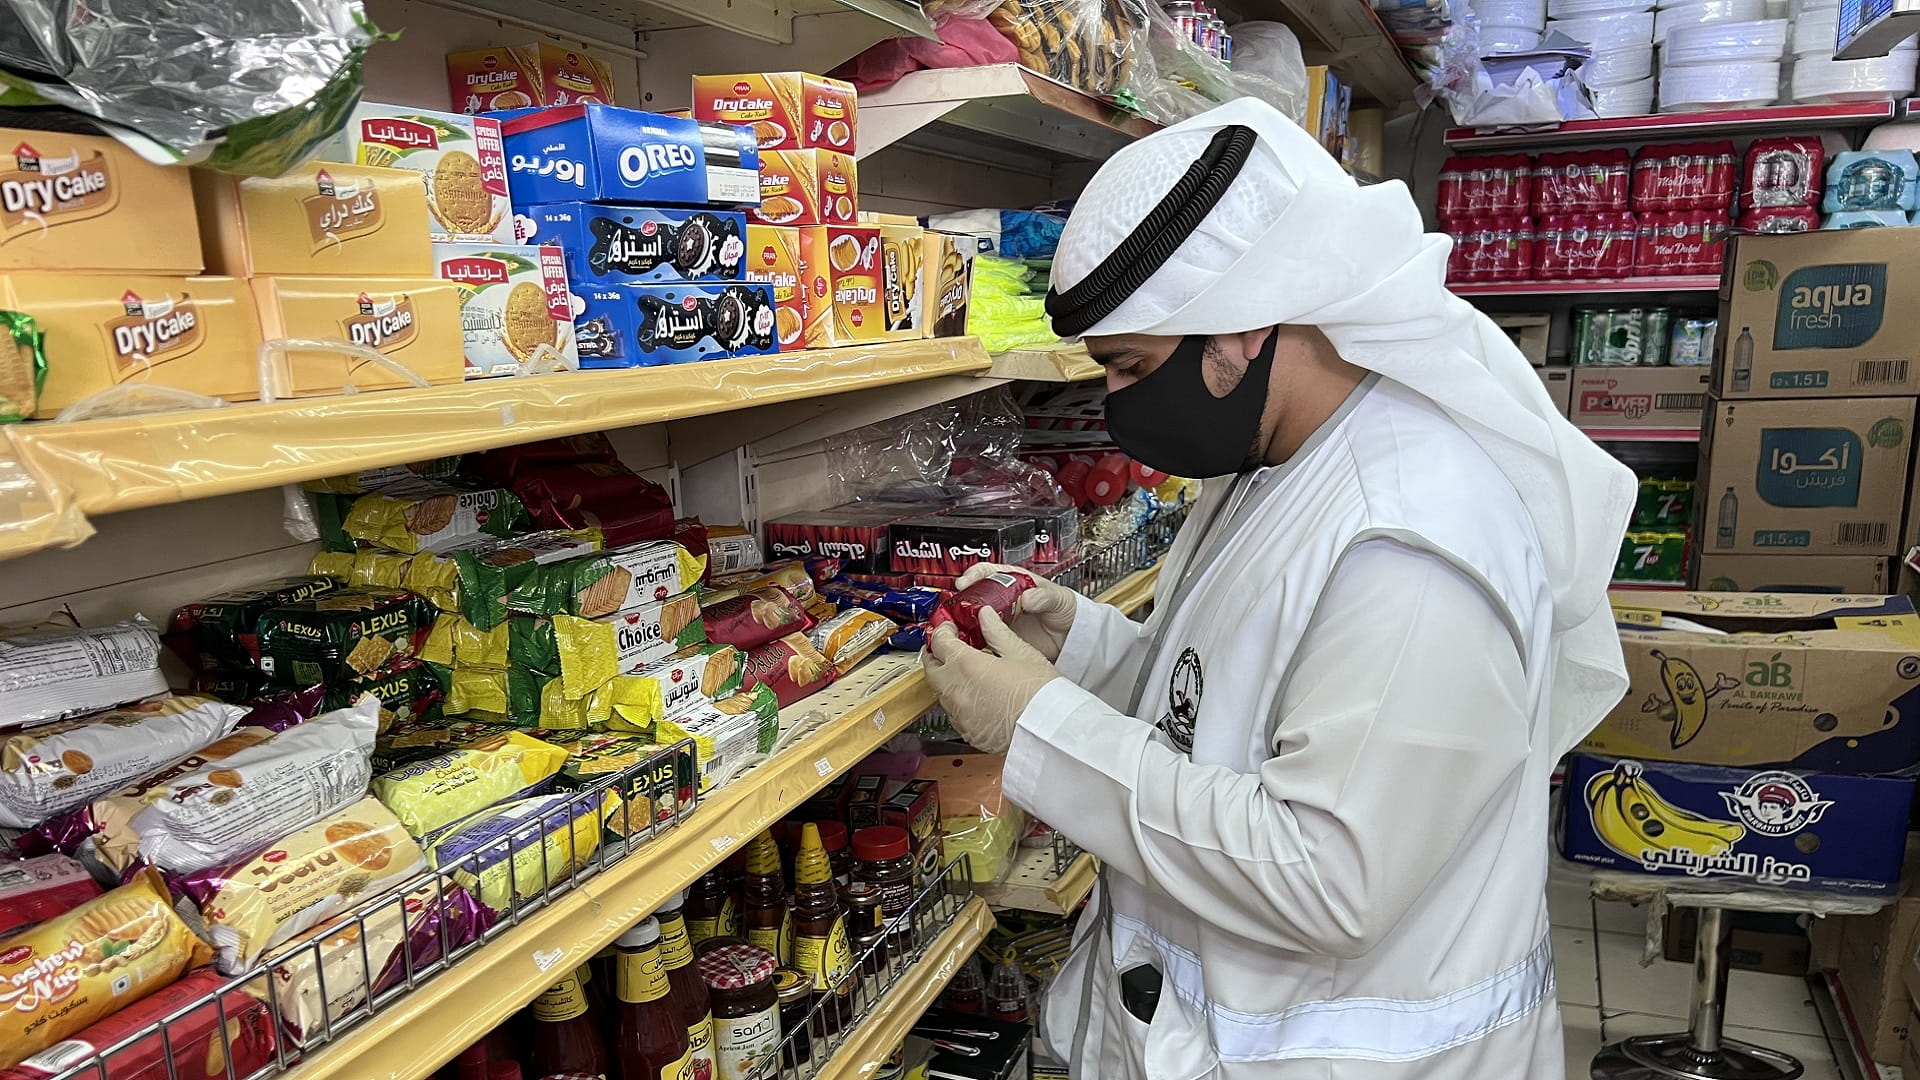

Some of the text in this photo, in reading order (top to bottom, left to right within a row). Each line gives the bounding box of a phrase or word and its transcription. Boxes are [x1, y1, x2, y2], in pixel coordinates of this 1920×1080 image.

[713, 98, 773, 113] DryCake
[368, 123, 433, 147] بريتانيا
[475, 126, 498, 139] SPECIAL
[477, 137, 501, 151] OFFER
[480, 153, 502, 168] عرض
[619, 143, 696, 182] OREO
[482, 166, 504, 182] خاص
[1656, 173, 1704, 189] Mai Dubai
[319, 191, 375, 232] كيك دراي
[545, 213, 554, 222] 14
[763, 250, 777, 260] PRAN
[1654, 241, 1702, 257] Mai Dubai
[541, 255, 562, 268] SPECIAL
[446, 262, 503, 282] بريتانيا
[543, 265, 564, 280] OFFER
[546, 281, 566, 295] عرض
[593, 291, 602, 300] 14
[609, 291, 620, 301] 36g
[547, 293, 567, 309] خاص
[1791, 284, 1872, 315] aqua
[1790, 307, 1842, 330] fresh
[1794, 374, 1814, 387] 1.5
[1587, 396, 1649, 411] POWER
[1771, 441, 1850, 475] أكوا
[1796, 471, 1846, 489] فريش
[460, 490, 498, 509] Choice
[896, 544, 991, 564] فحم الشعلة
[362, 610, 408, 638] LEXUS
[286, 623, 323, 643] LEXUS
[618, 622, 662, 651] Choice
[371, 679, 409, 702] EXUS
[1732, 690, 1747, 699] AL
[1769, 702, 1820, 713] Paradise
[371, 755, 389, 769] XUS
[1640, 847, 1811, 885] موز الشربتلي
[16, 967, 81, 1011] Nut
